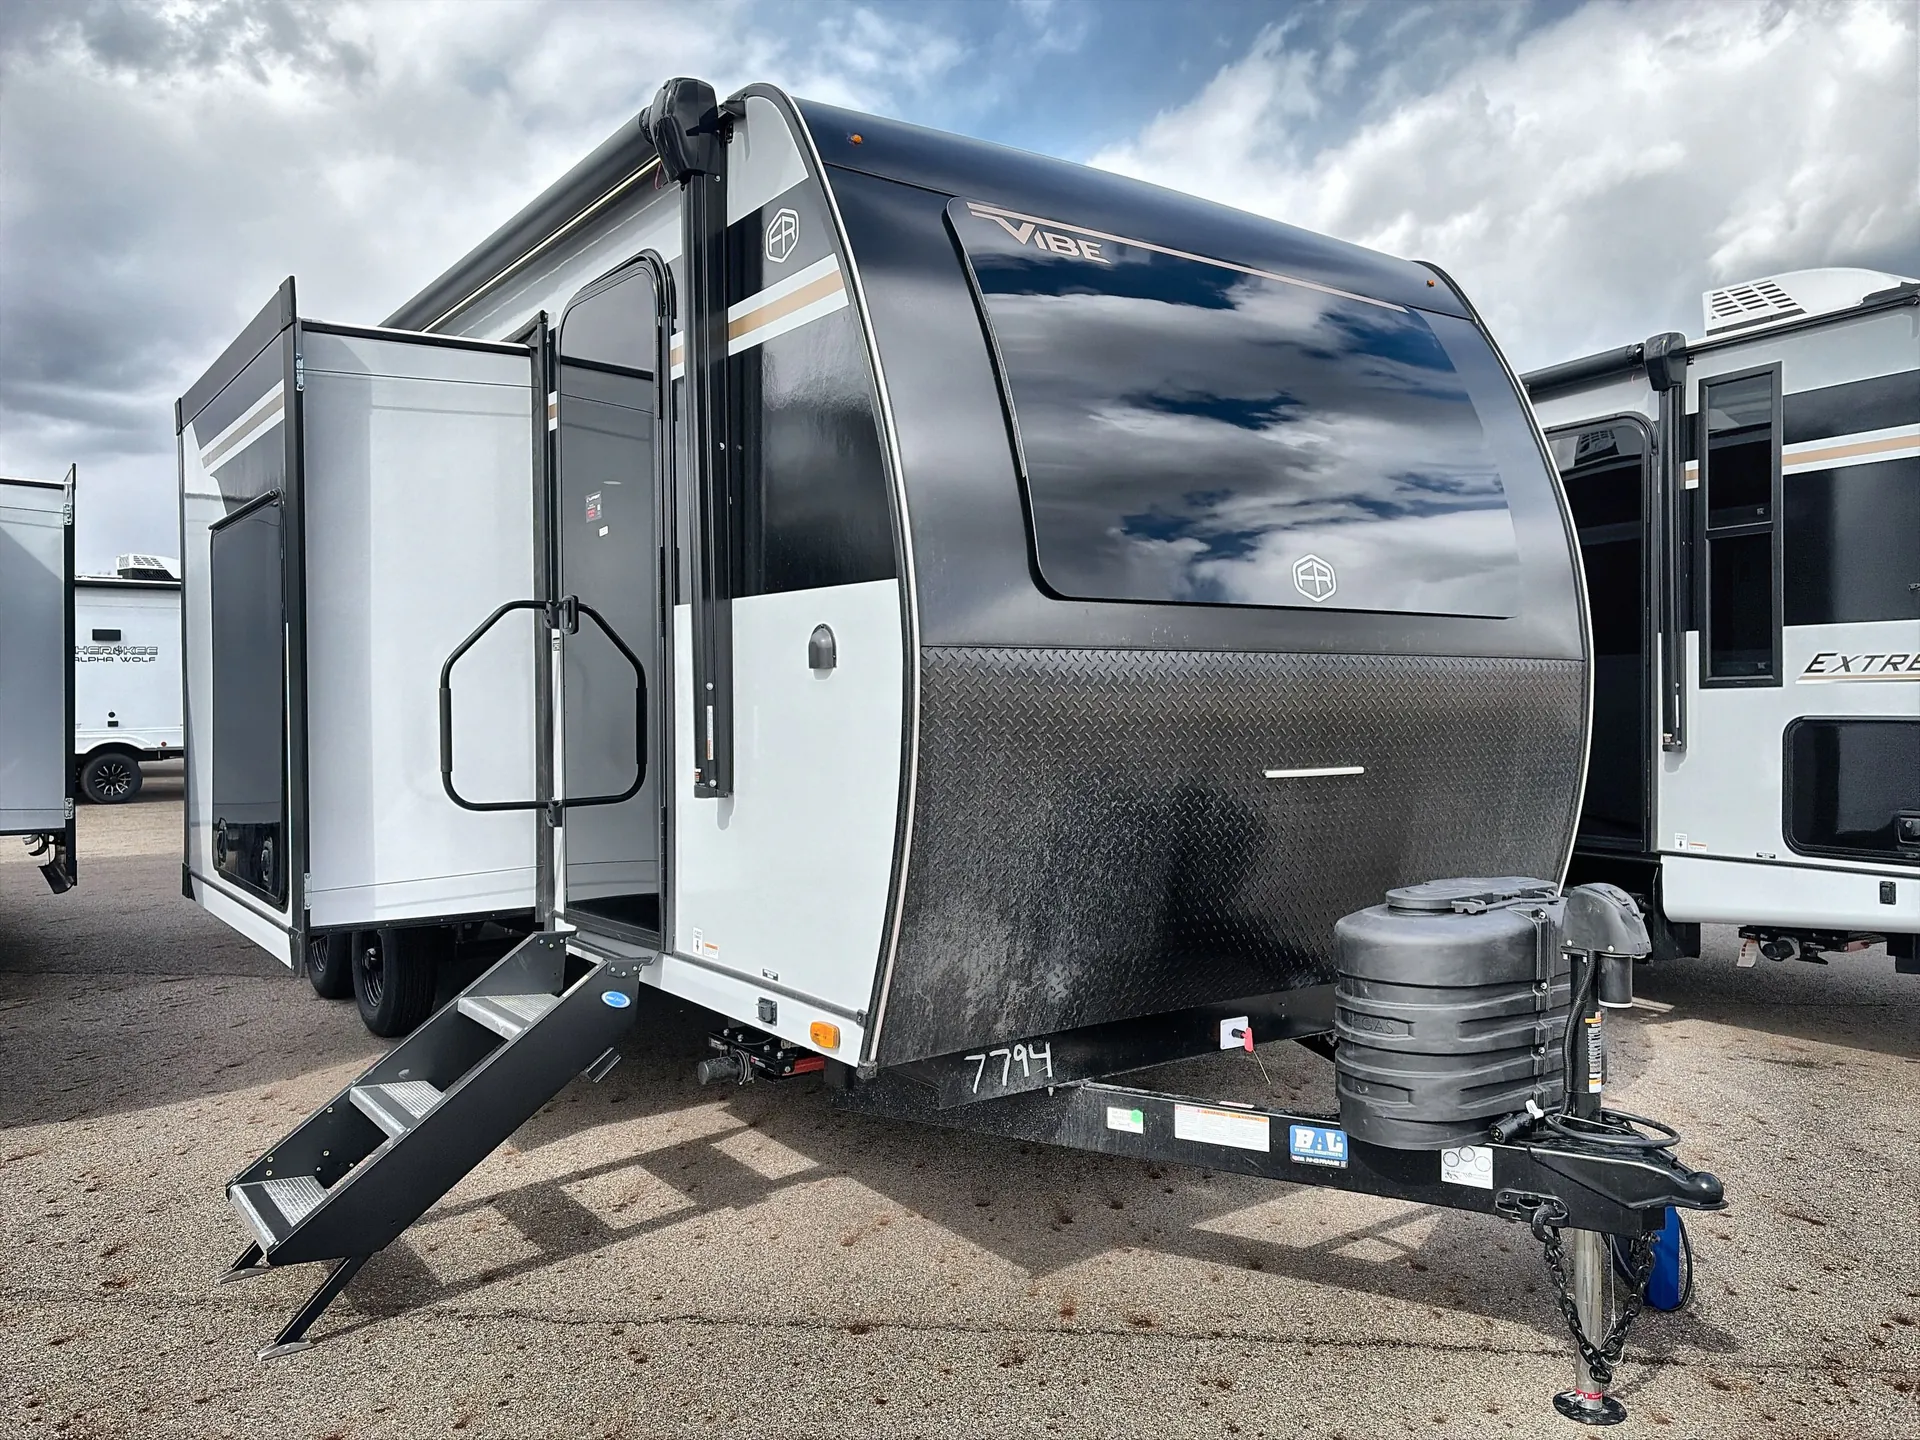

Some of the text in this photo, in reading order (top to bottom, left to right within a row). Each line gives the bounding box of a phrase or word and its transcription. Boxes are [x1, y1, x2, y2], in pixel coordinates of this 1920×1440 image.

[970, 210, 1111, 264] VIBE
[75, 645, 158, 656] HEROKEE
[1803, 652, 1920, 674] EXTRE
[1362, 1016, 1394, 1035] GAS
[963, 1041, 1053, 1094] 7794
[1294, 1128, 1344, 1153] BAL
